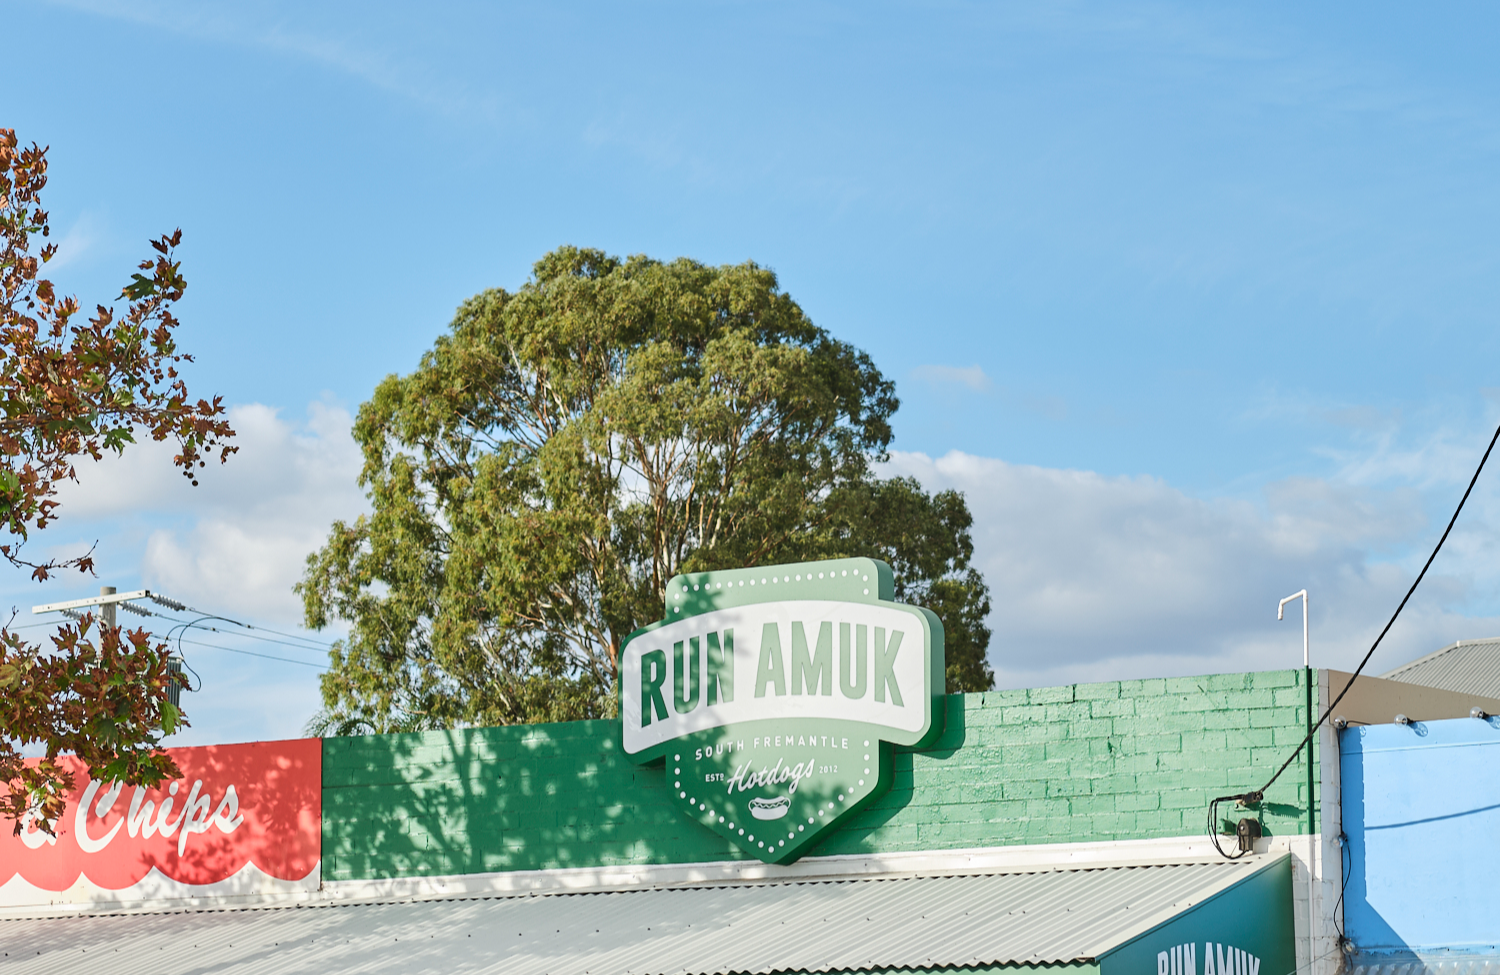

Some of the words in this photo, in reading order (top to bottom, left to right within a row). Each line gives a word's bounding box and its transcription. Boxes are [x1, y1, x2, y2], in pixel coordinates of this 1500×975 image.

[640, 627, 734, 728] RUN
[754, 620, 905, 708] AMUK
[695, 739, 744, 760] SOUTH
[753, 735, 849, 749] FREMANTLE
[726, 757, 815, 795] Hotdogs
[819, 765, 838, 774] 2012
[21, 779, 59, 849] &
[74, 777, 244, 858] Chips
